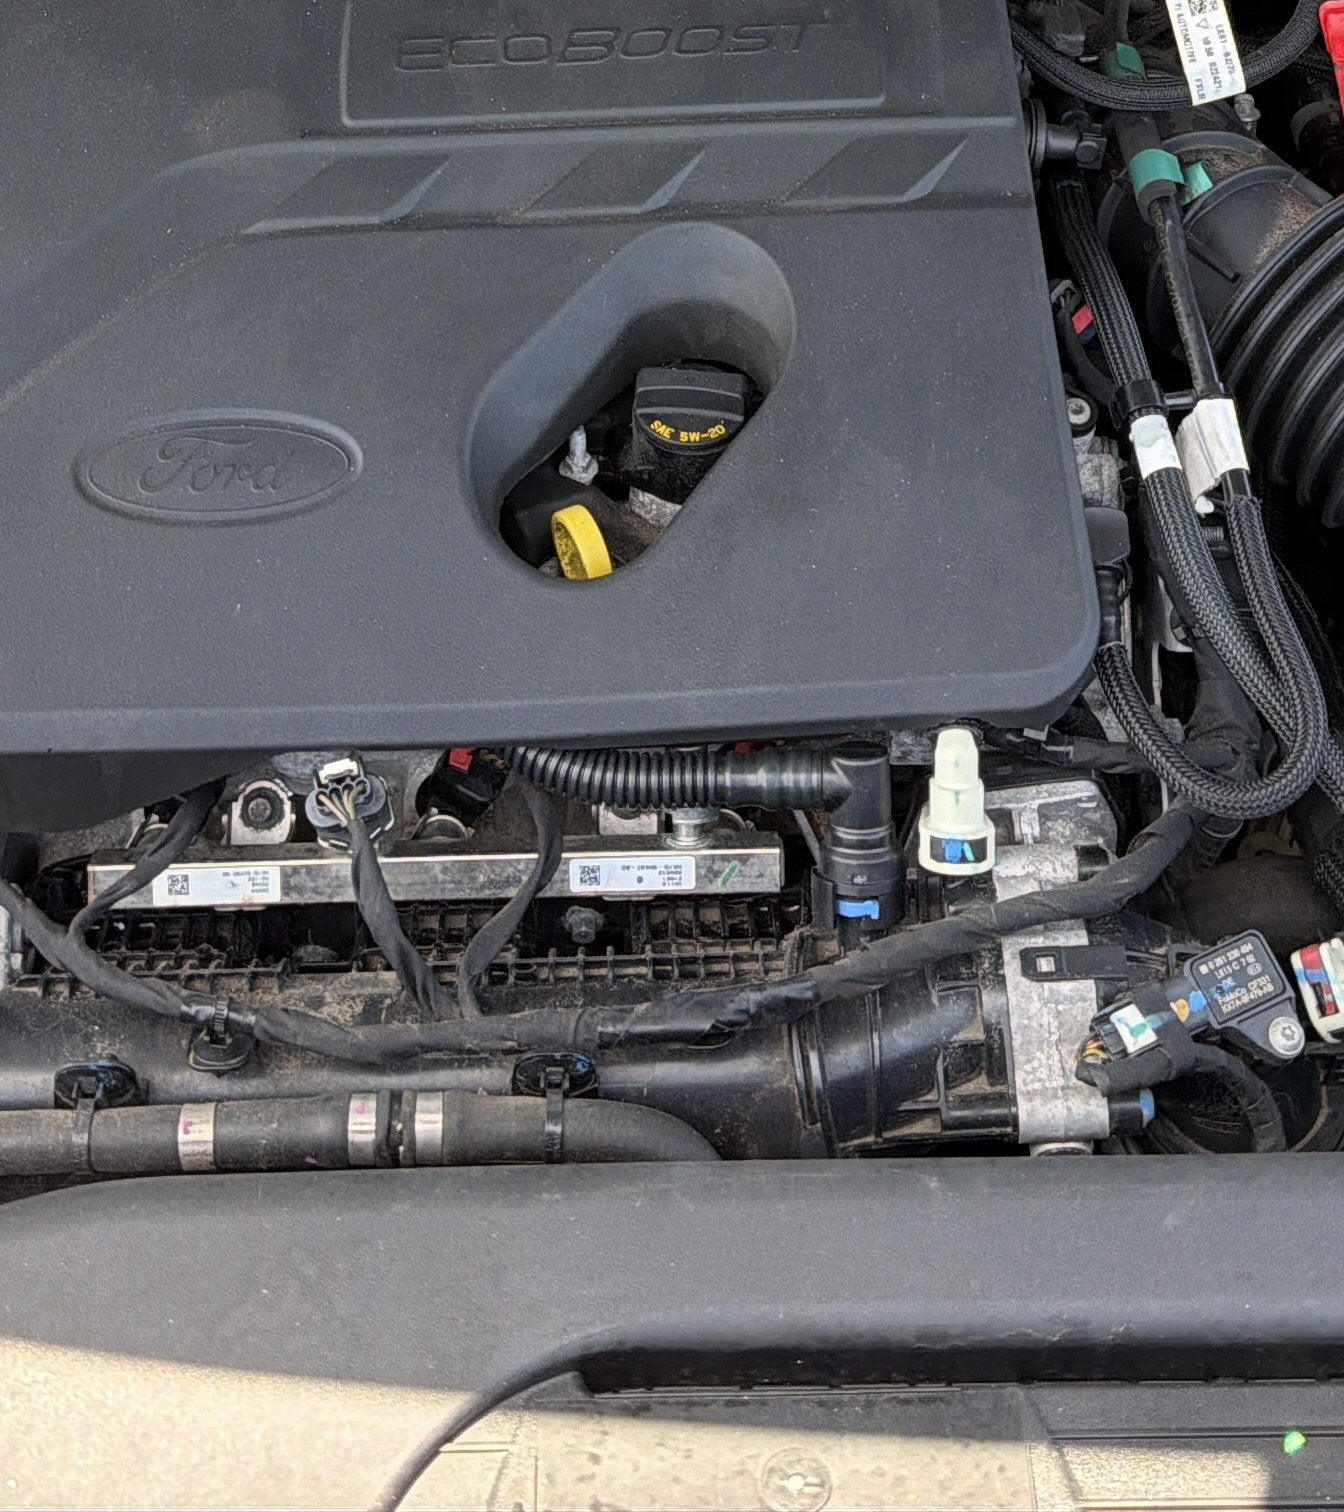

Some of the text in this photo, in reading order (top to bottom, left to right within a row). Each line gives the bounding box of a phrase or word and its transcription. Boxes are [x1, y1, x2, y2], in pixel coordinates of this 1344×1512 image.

[650, 420, 726, 442] SAE 5W-20
[138, 437, 296, 494] Ford
